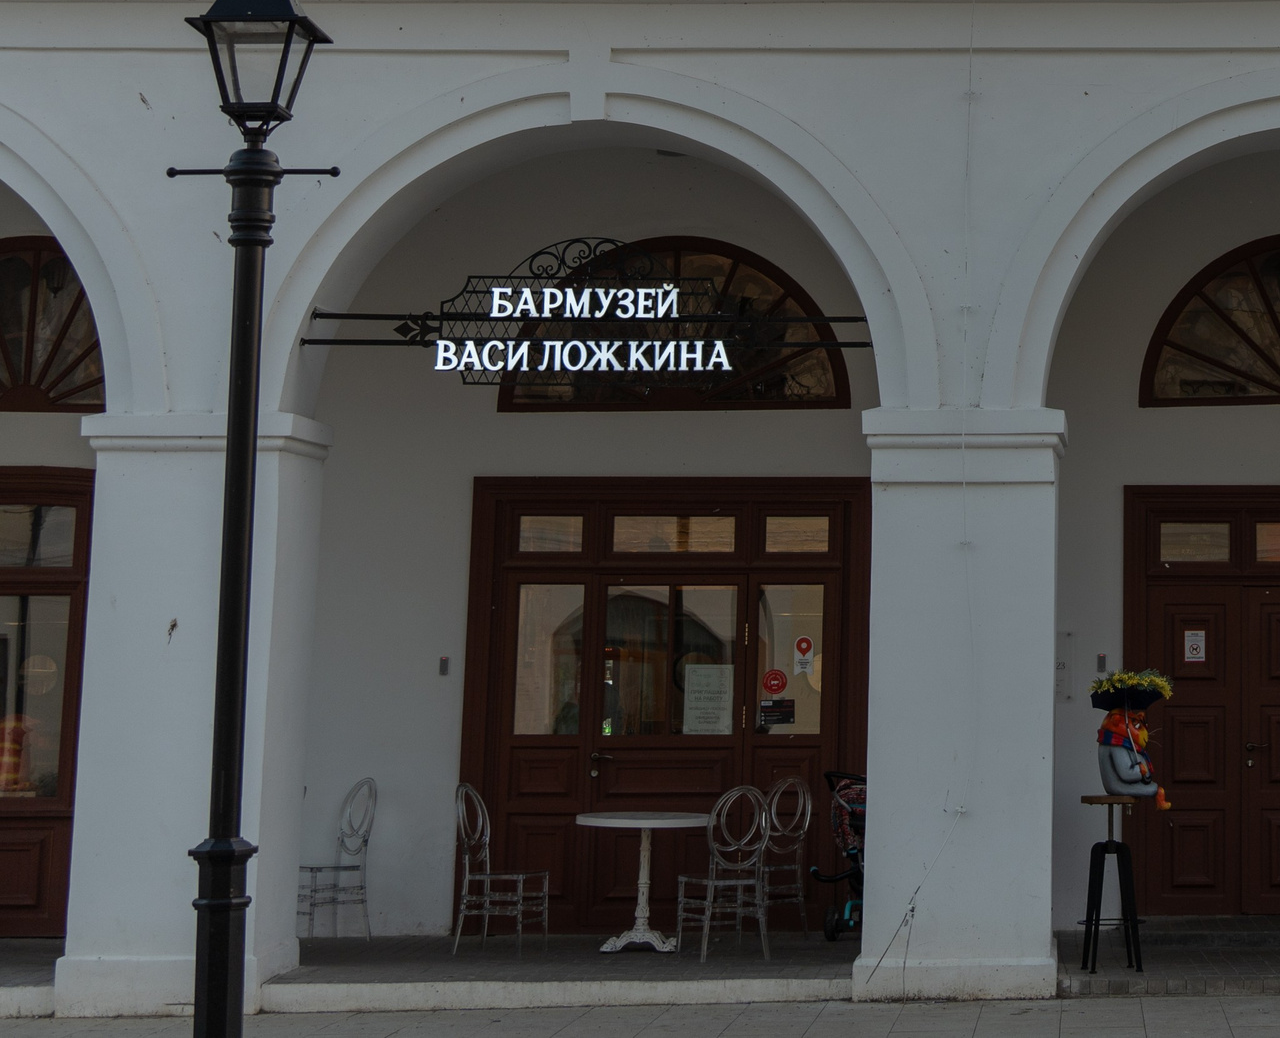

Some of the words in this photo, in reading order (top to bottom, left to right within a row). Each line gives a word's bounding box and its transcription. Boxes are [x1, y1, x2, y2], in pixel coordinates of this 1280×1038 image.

[489, 283, 680, 318] БАРМУЗЕЙ
[435, 340, 530, 371] ВАСИ
[537, 340, 733, 371] ЛОЖКИНА
